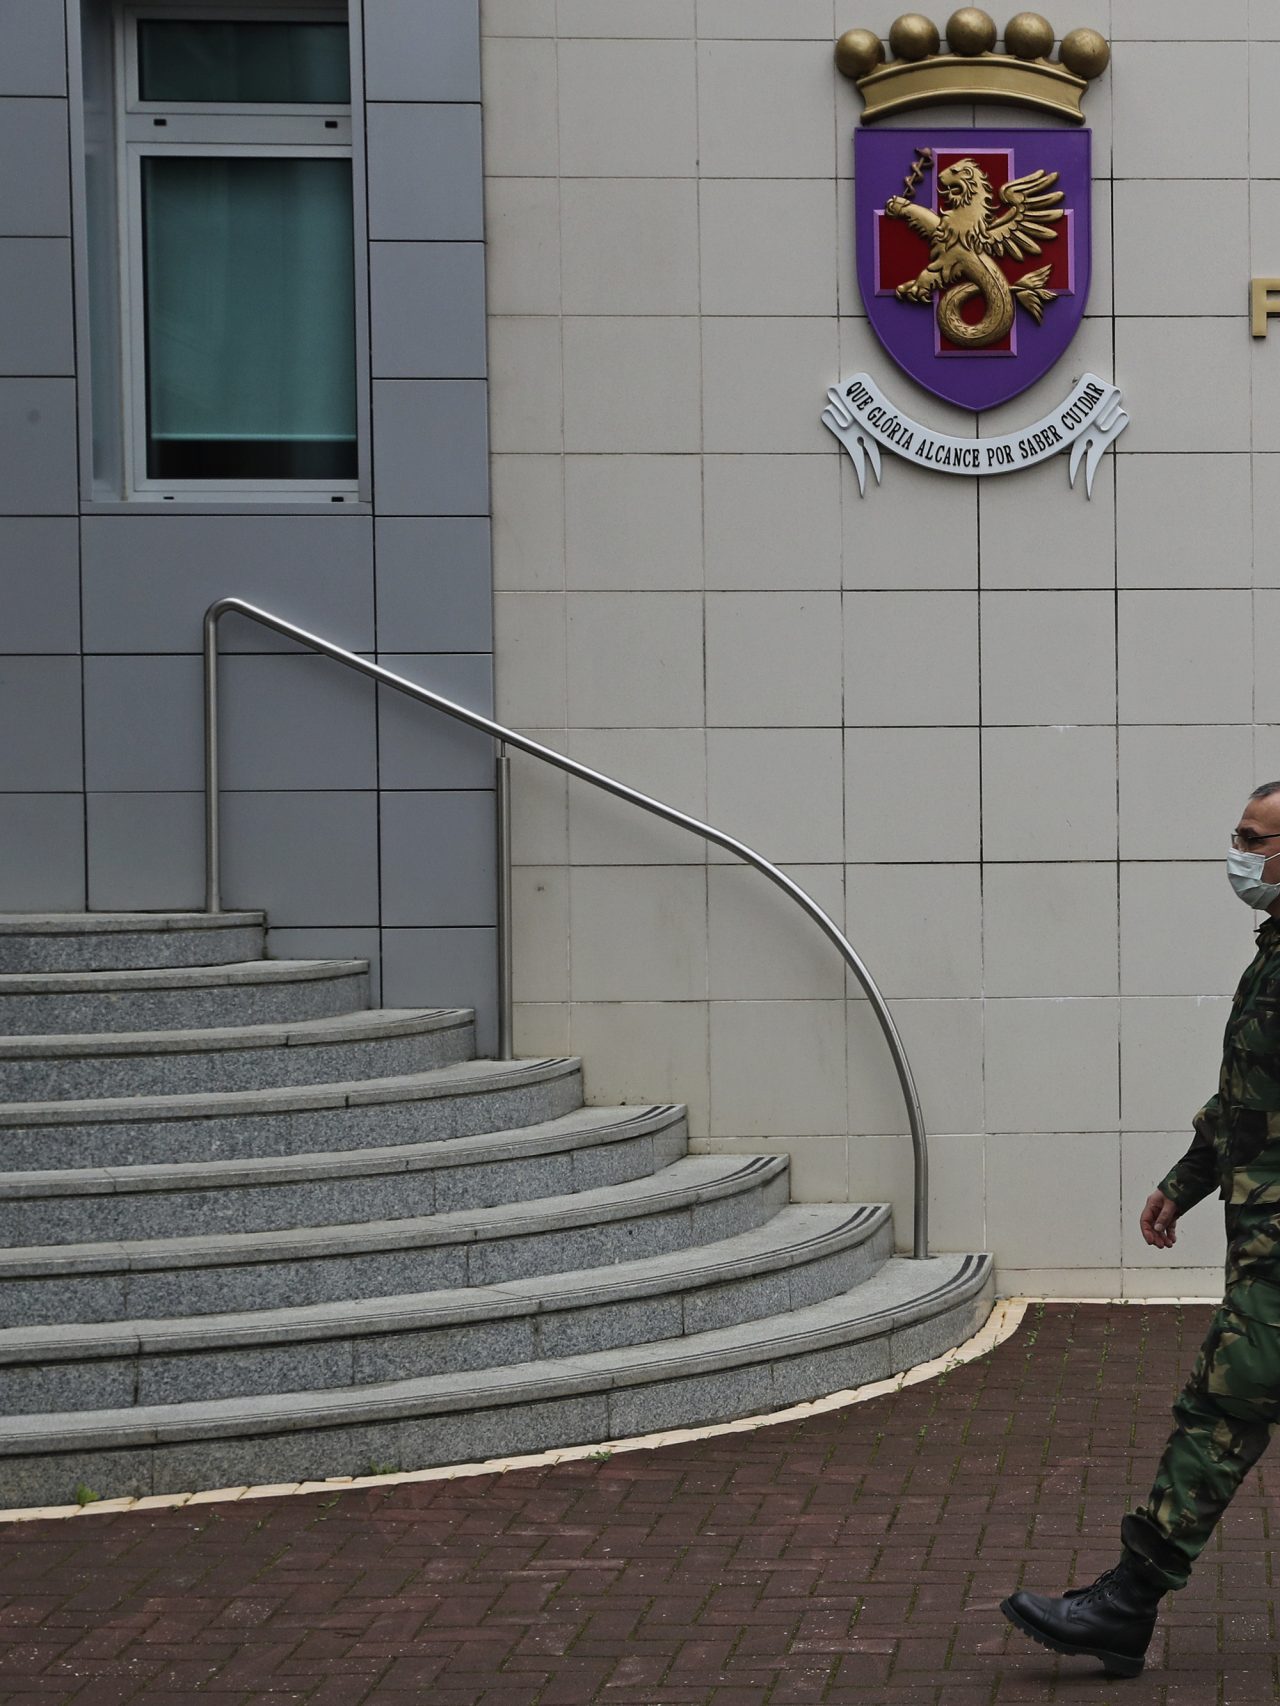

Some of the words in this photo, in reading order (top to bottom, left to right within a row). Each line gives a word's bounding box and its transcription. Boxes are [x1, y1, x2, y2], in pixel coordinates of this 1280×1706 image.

[846, 381, 874, 411] QUE
[867, 406, 914, 450] GLÓRIA
[915, 439, 980, 468] ALCANCE
[986, 444, 1015, 467] POR
[1018, 424, 1063, 459] SABER
[1061, 382, 1105, 431] CUIDAR
